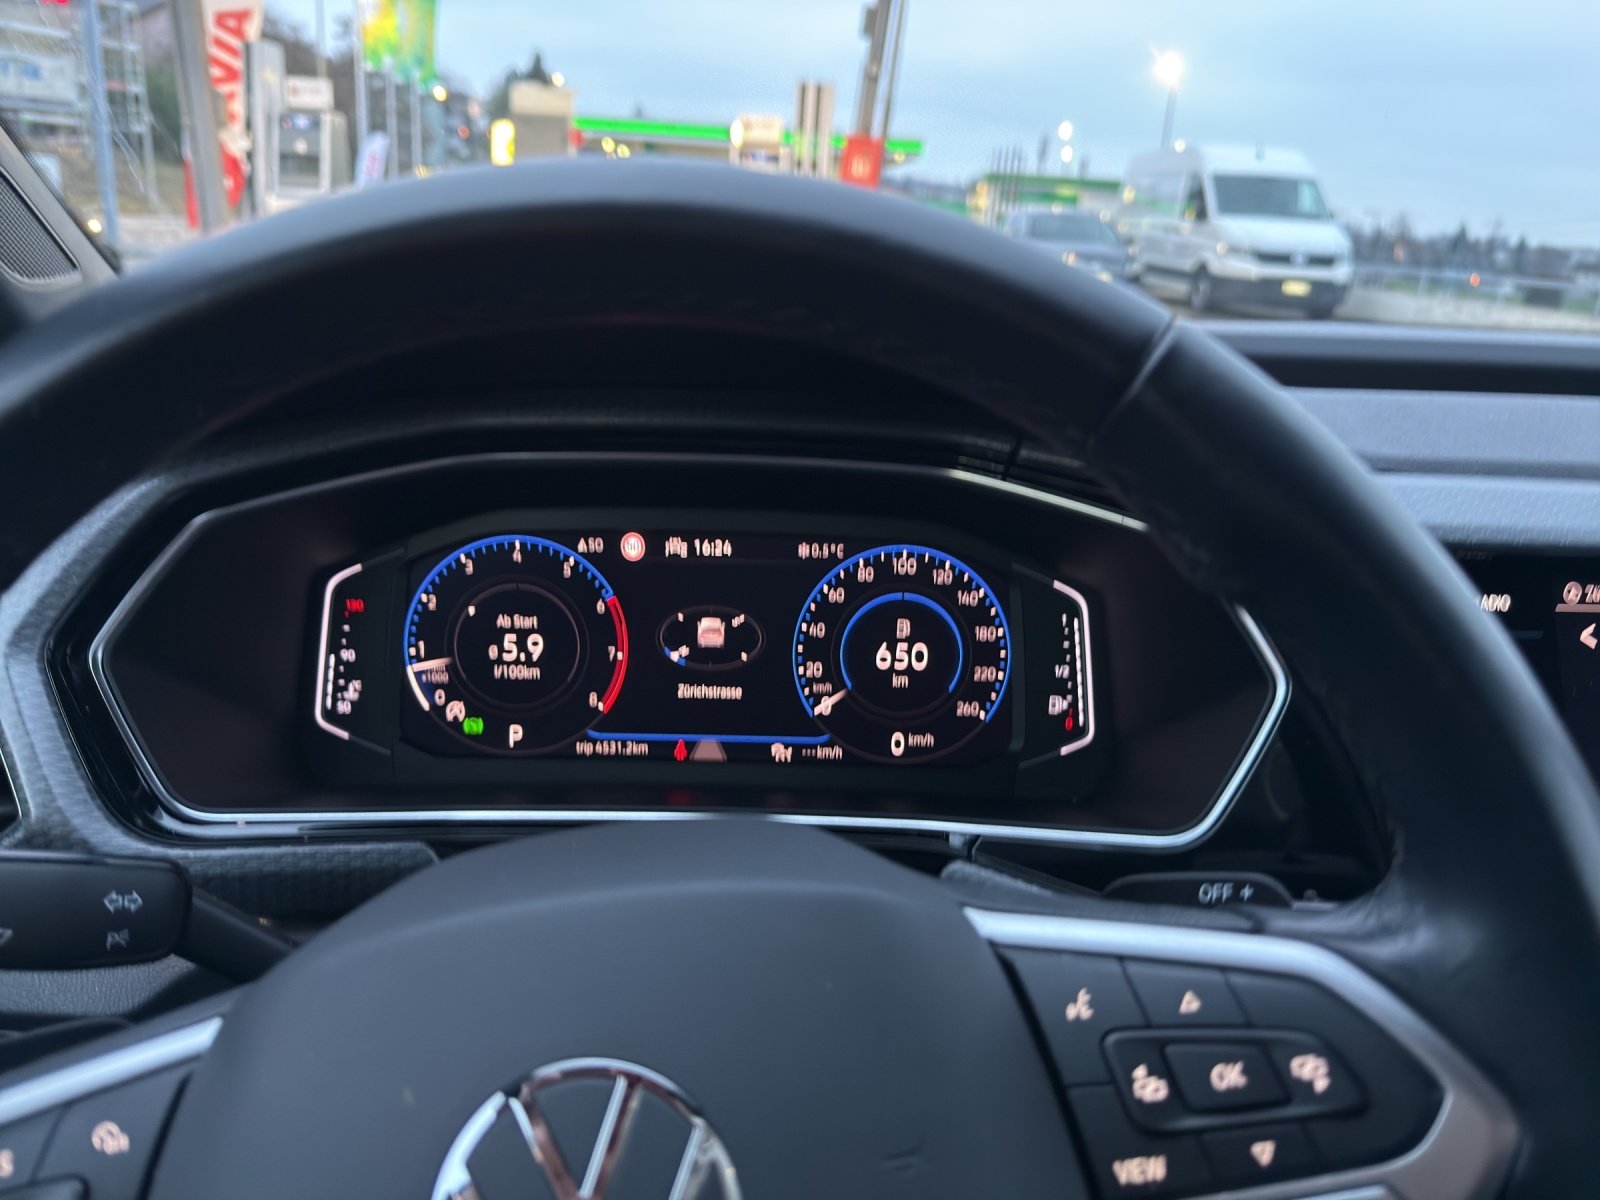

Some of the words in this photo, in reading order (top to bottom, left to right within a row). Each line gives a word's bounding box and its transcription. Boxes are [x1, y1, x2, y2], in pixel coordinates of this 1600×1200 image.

[857, 566, 875, 583] 80
[892, 556, 917, 576] 100
[932, 568, 953, 586] 120
[827, 586, 845, 603] 60
[957, 589, 979, 607] 140
[496, 613, 512, 629] Ab
[513, 613, 538, 630] Start
[809, 622, 826, 639] 40
[975, 625, 997, 642] 180
[340, 648, 356, 663] 90
[501, 633, 544, 663] 5.9
[875, 641, 929, 672] 650
[806, 661, 823, 678] 20
[974, 665, 997, 682] 220
[892, 672, 909, 689] km
[956, 700, 980, 717] 260
[508, 723, 524, 749] P
[890, 731, 905, 757] 0
[908, 732, 934, 748] km/h
[575, 740, 594, 757] trip
[1198, 883, 1233, 904] OFF
[1210, 1061, 1248, 1092] OK
[1112, 1154, 1168, 1186] VIEW
